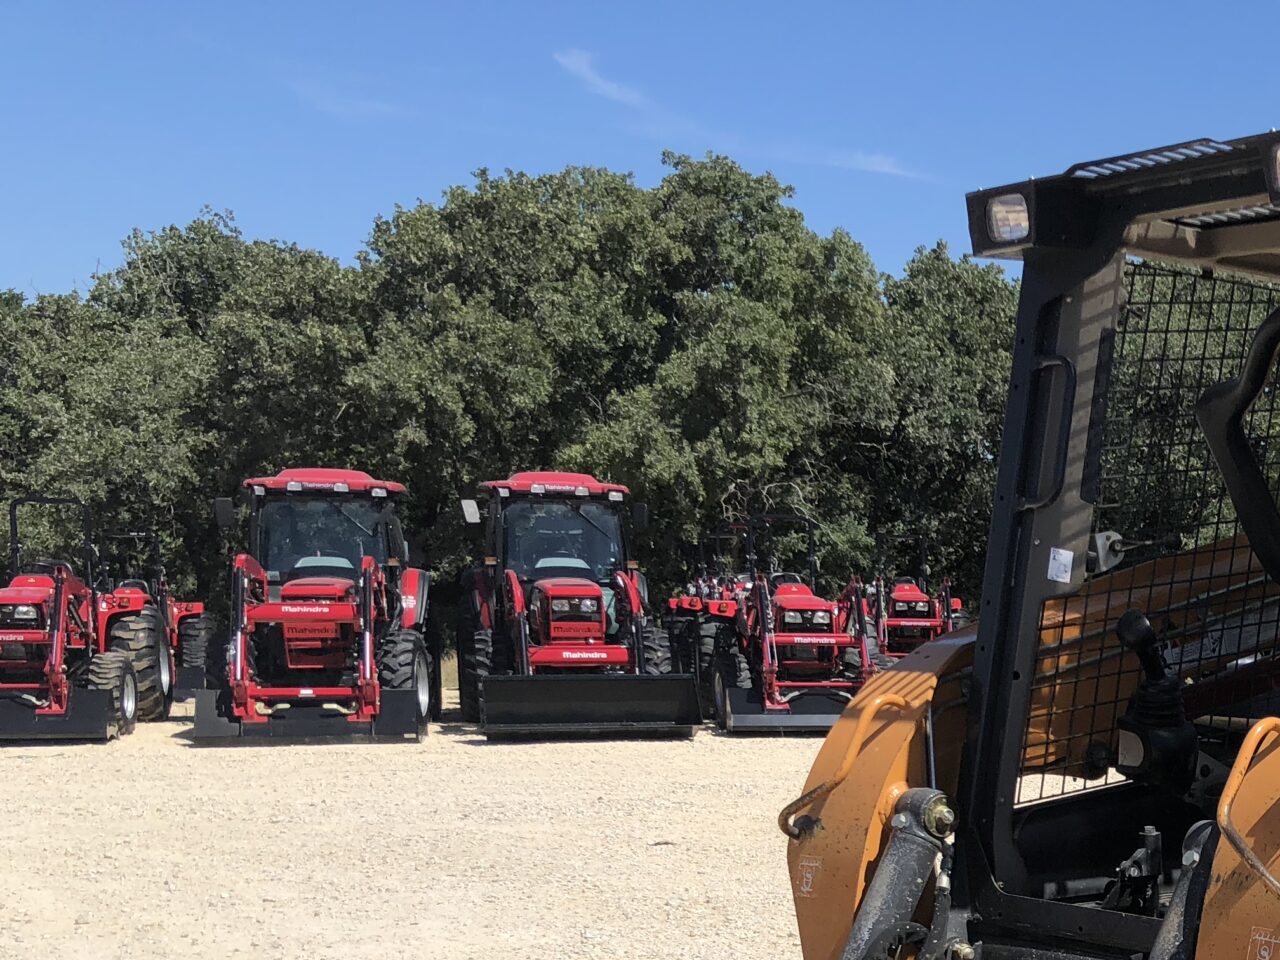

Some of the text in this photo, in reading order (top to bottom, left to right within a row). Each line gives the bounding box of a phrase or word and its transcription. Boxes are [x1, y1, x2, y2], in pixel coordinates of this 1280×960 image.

[281, 605, 330, 613] Mahindra
[793, 636, 837, 644] Mahindra
[562, 651, 608, 659] Mahindra
